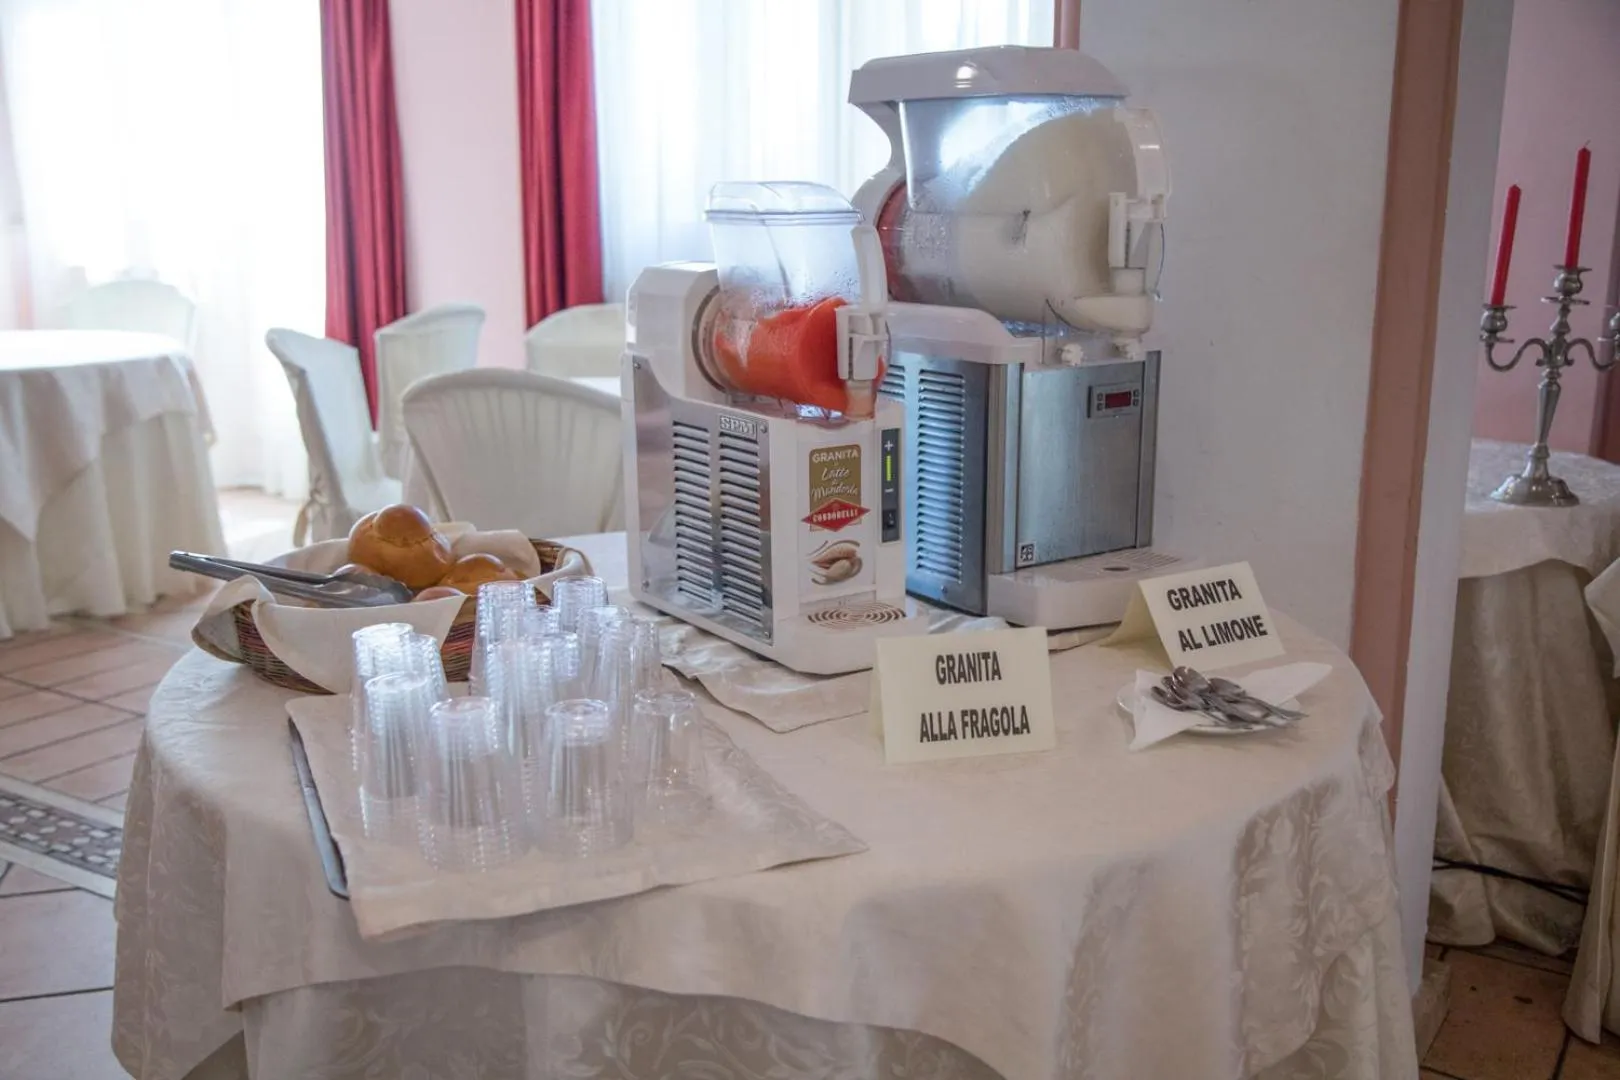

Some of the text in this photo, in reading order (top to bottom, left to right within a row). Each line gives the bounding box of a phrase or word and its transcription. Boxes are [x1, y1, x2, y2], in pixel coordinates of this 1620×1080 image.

[812, 449, 859, 463] GRANITA
[1166, 579, 1242, 611] GRANITA
[1178, 615, 1268, 652] AL LIMONE
[936, 651, 1002, 685] GRANITA
[920, 705, 1031, 743] ALLA FRAGOLA
